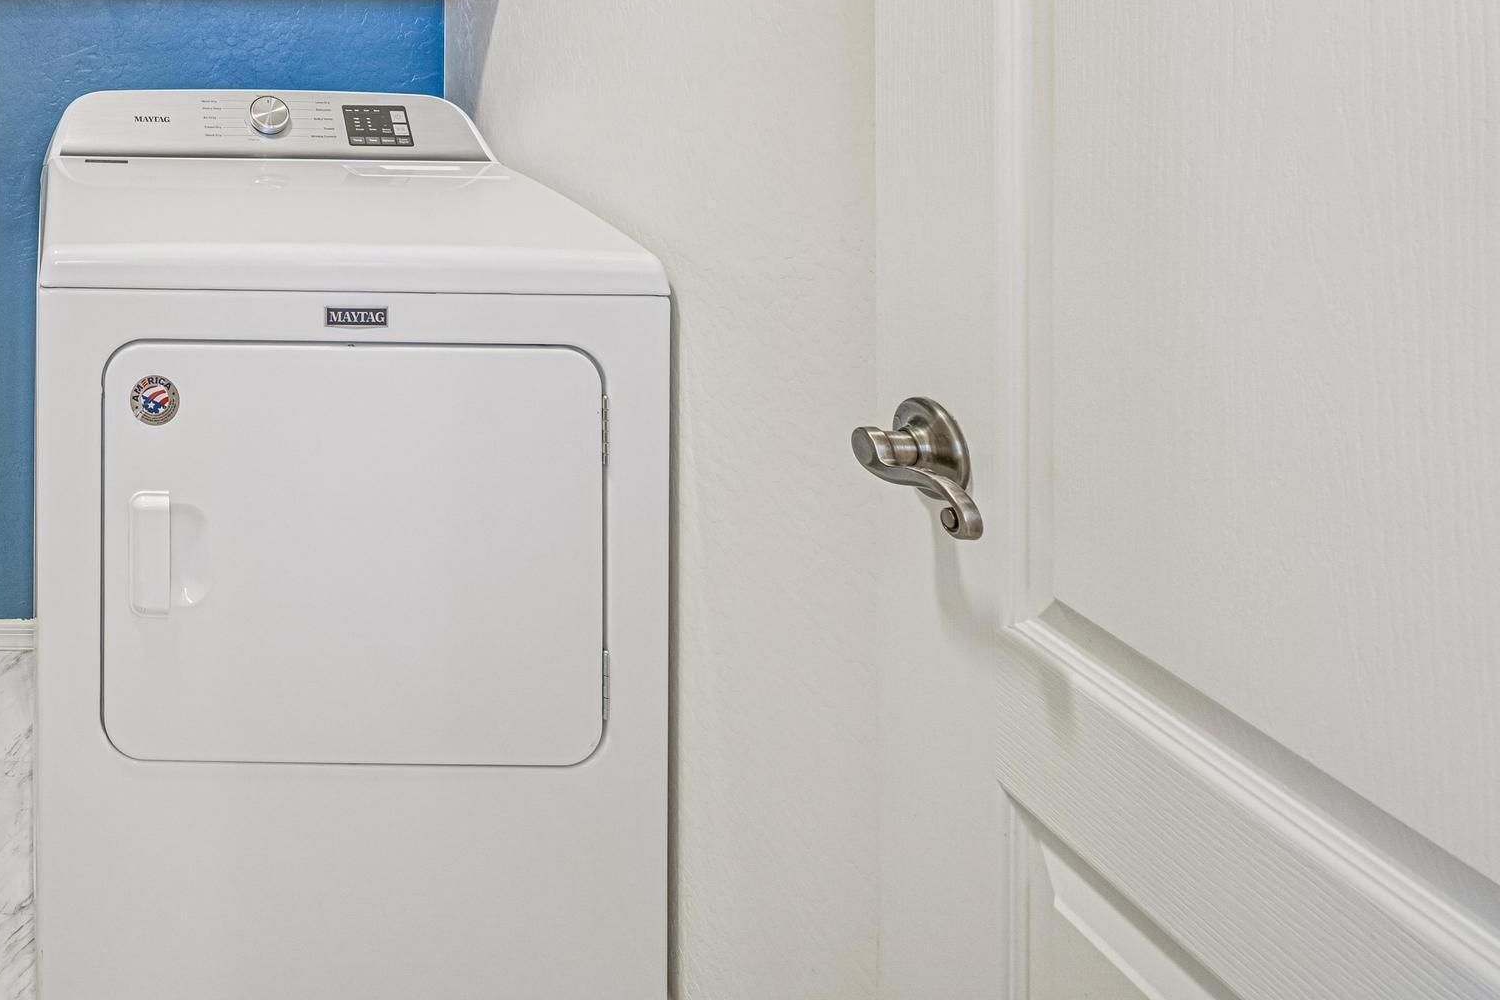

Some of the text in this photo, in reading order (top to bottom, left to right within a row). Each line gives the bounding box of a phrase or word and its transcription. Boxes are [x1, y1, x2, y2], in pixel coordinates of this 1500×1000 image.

[134, 115, 171, 123] MAYTAG
[329, 310, 386, 323] MAYTAG
[132, 377, 172, 402] AMERICA
